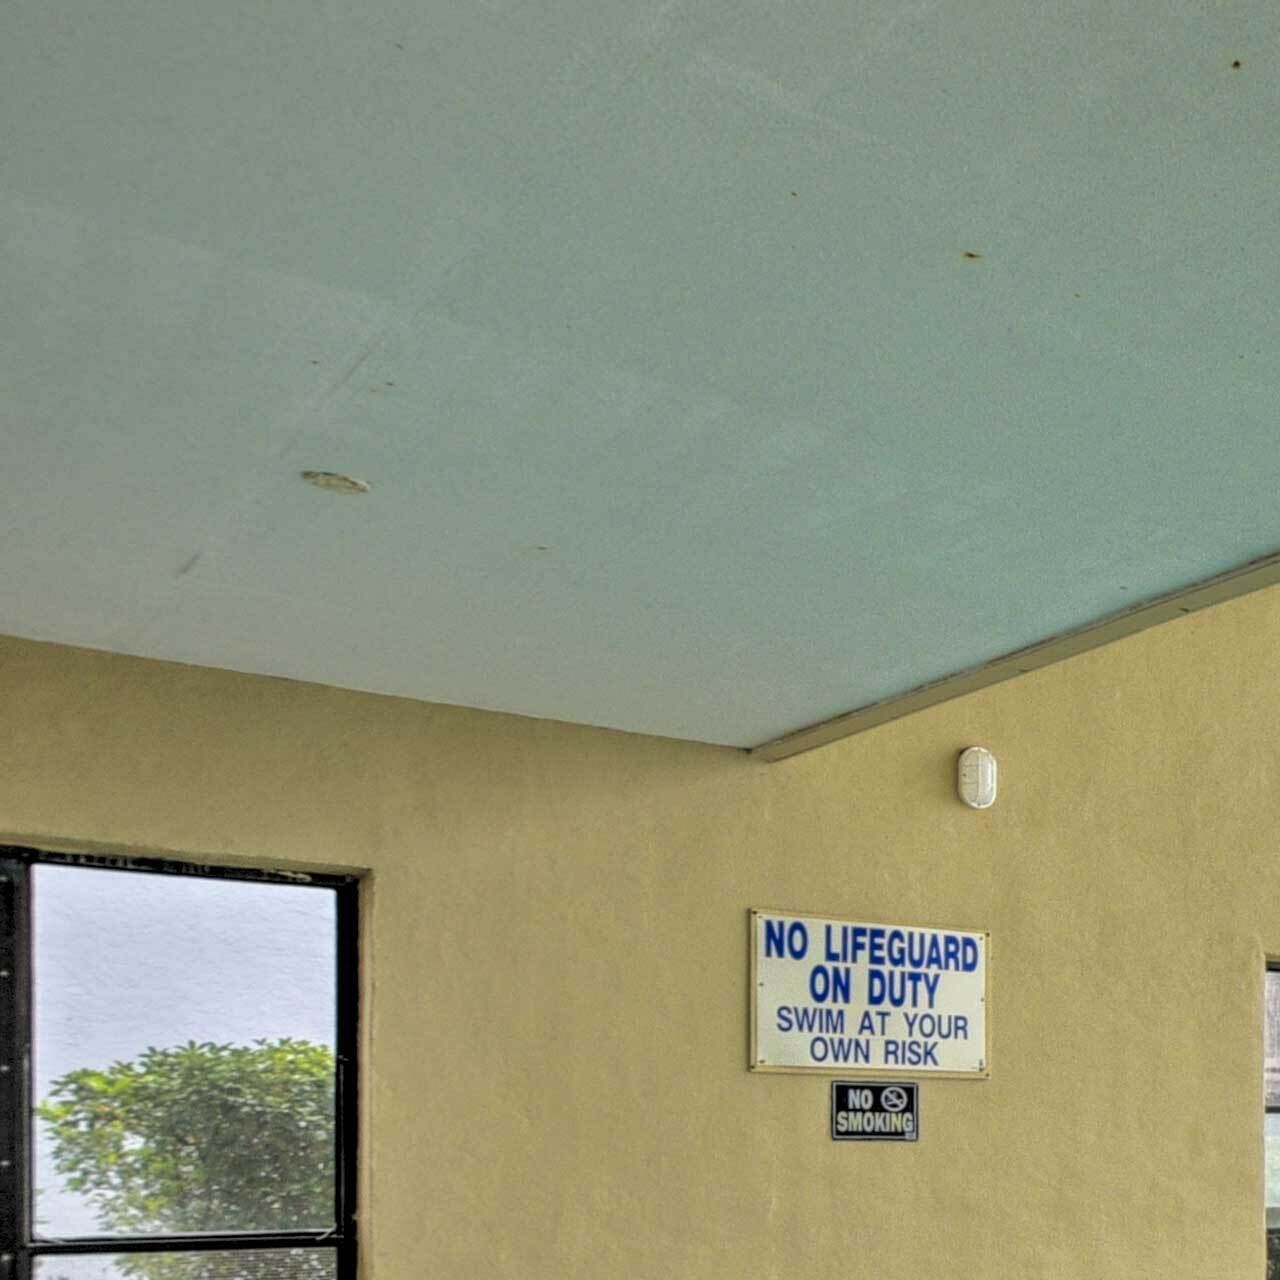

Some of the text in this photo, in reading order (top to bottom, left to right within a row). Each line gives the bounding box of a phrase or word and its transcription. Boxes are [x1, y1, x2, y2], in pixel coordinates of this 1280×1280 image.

[764, 919, 979, 973] NO LIFEGUARD
[809, 964, 941, 1009] ON DUTY
[776, 1005, 969, 1040] SWIM AT YOUR
[810, 1036, 939, 1067] OWN RISK
[848, 1089, 873, 1110] NO
[836, 1112, 914, 1133] SMOKING
